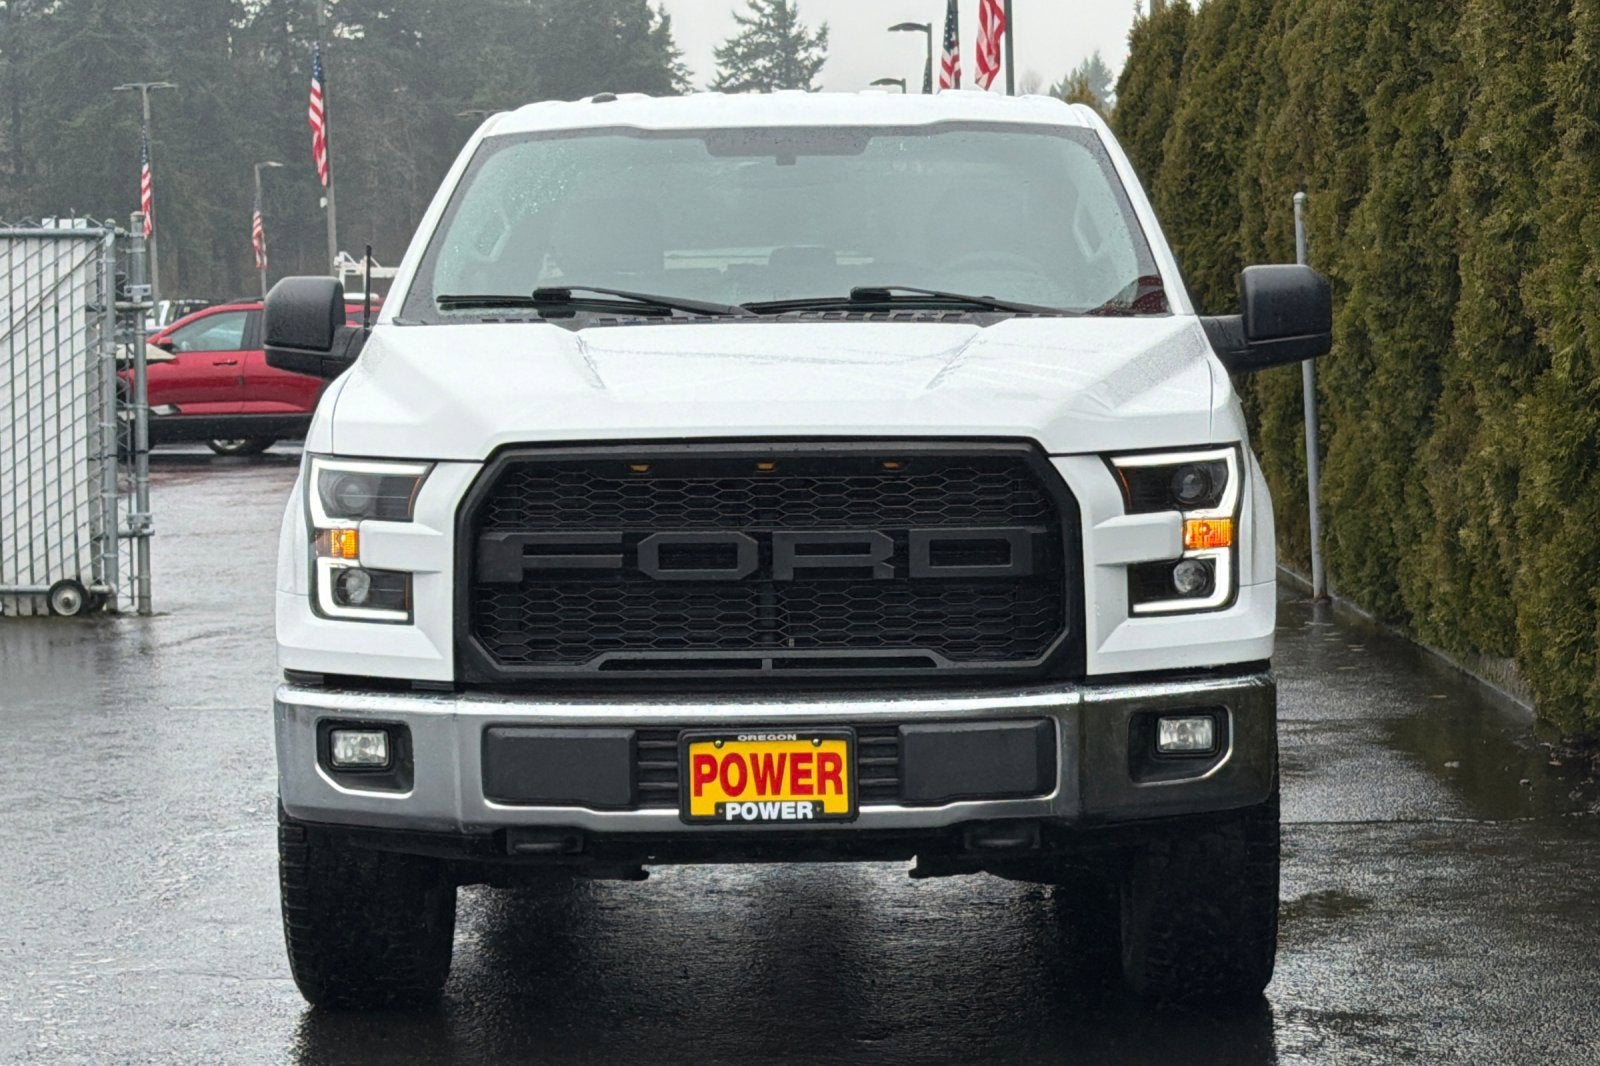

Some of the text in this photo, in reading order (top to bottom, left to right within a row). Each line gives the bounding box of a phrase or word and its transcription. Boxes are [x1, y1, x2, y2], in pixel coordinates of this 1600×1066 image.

[480, 527, 1042, 582] FORD
[737, 733, 797, 742] OREGON
[693, 752, 843, 797] POWER
[726, 801, 813, 820] POWER
